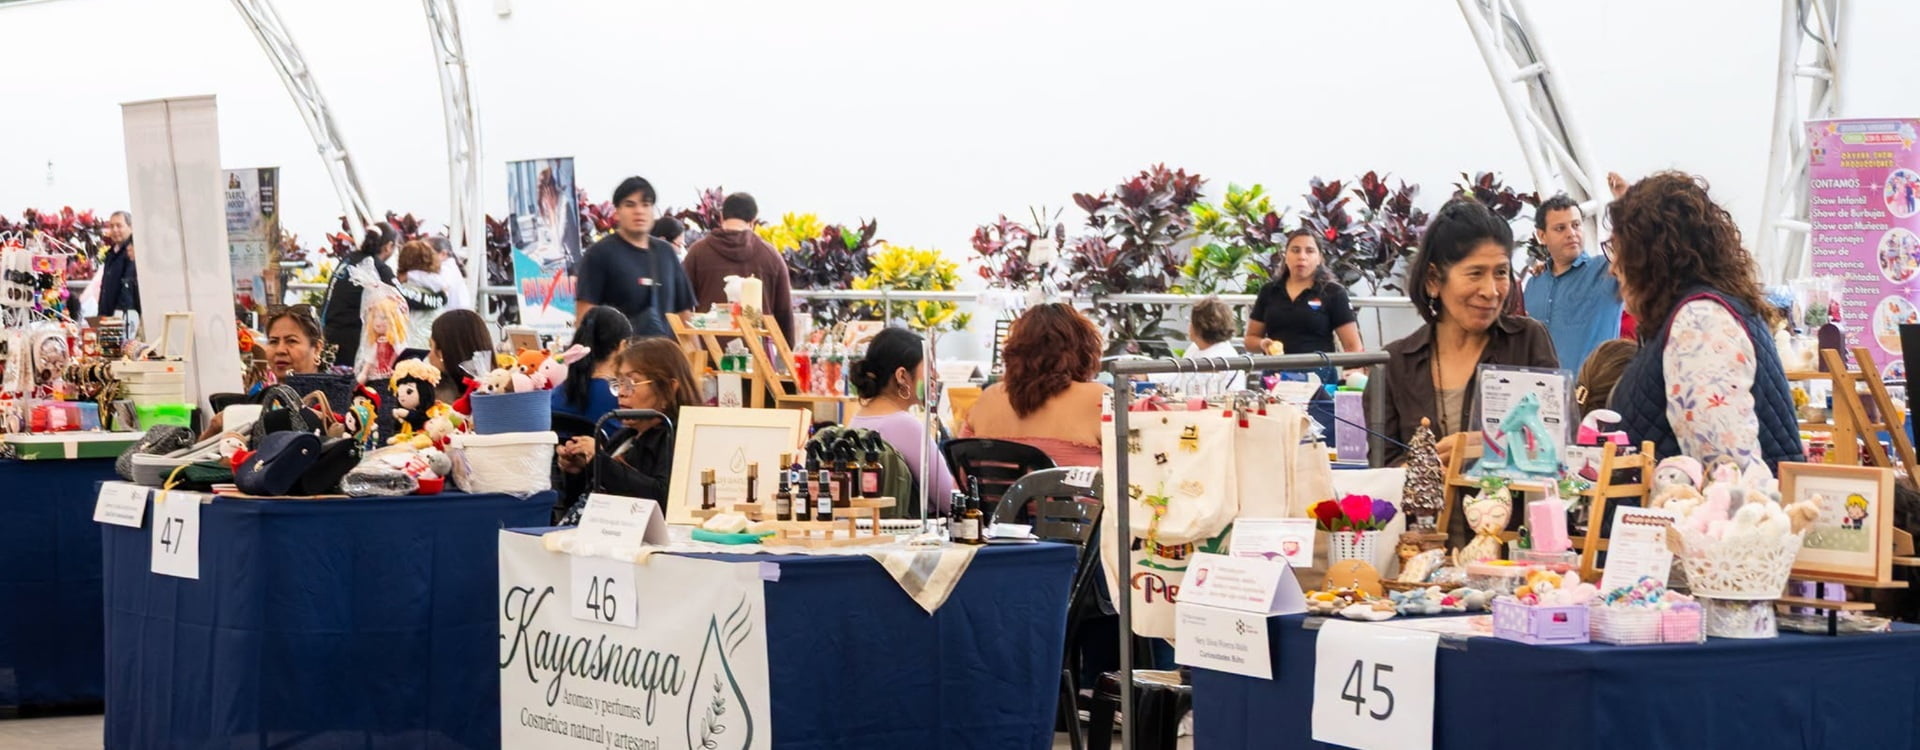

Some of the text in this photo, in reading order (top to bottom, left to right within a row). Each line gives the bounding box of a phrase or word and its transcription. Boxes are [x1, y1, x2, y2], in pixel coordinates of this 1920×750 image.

[1811, 179, 1860, 189] CONTAMOS
[1812, 195, 1867, 205] Show Infantil
[1812, 209, 1885, 219] Show de Burbujas
[1812, 222, 1836, 231] Show
[1838, 223, 1854, 231] con
[1818, 234, 1864, 245] Personajes
[1812, 246, 1849, 256] Show de
[1813, 260, 1865, 270] competencia
[161, 517, 184, 554] 47
[1130, 571, 1180, 604] Pe
[586, 576, 617, 622] 46
[1341, 660, 1395, 721] 45
[562, 688, 641, 720] Aromas y perfumes
[520, 707, 660, 750] Cosmética natural y artesanal
